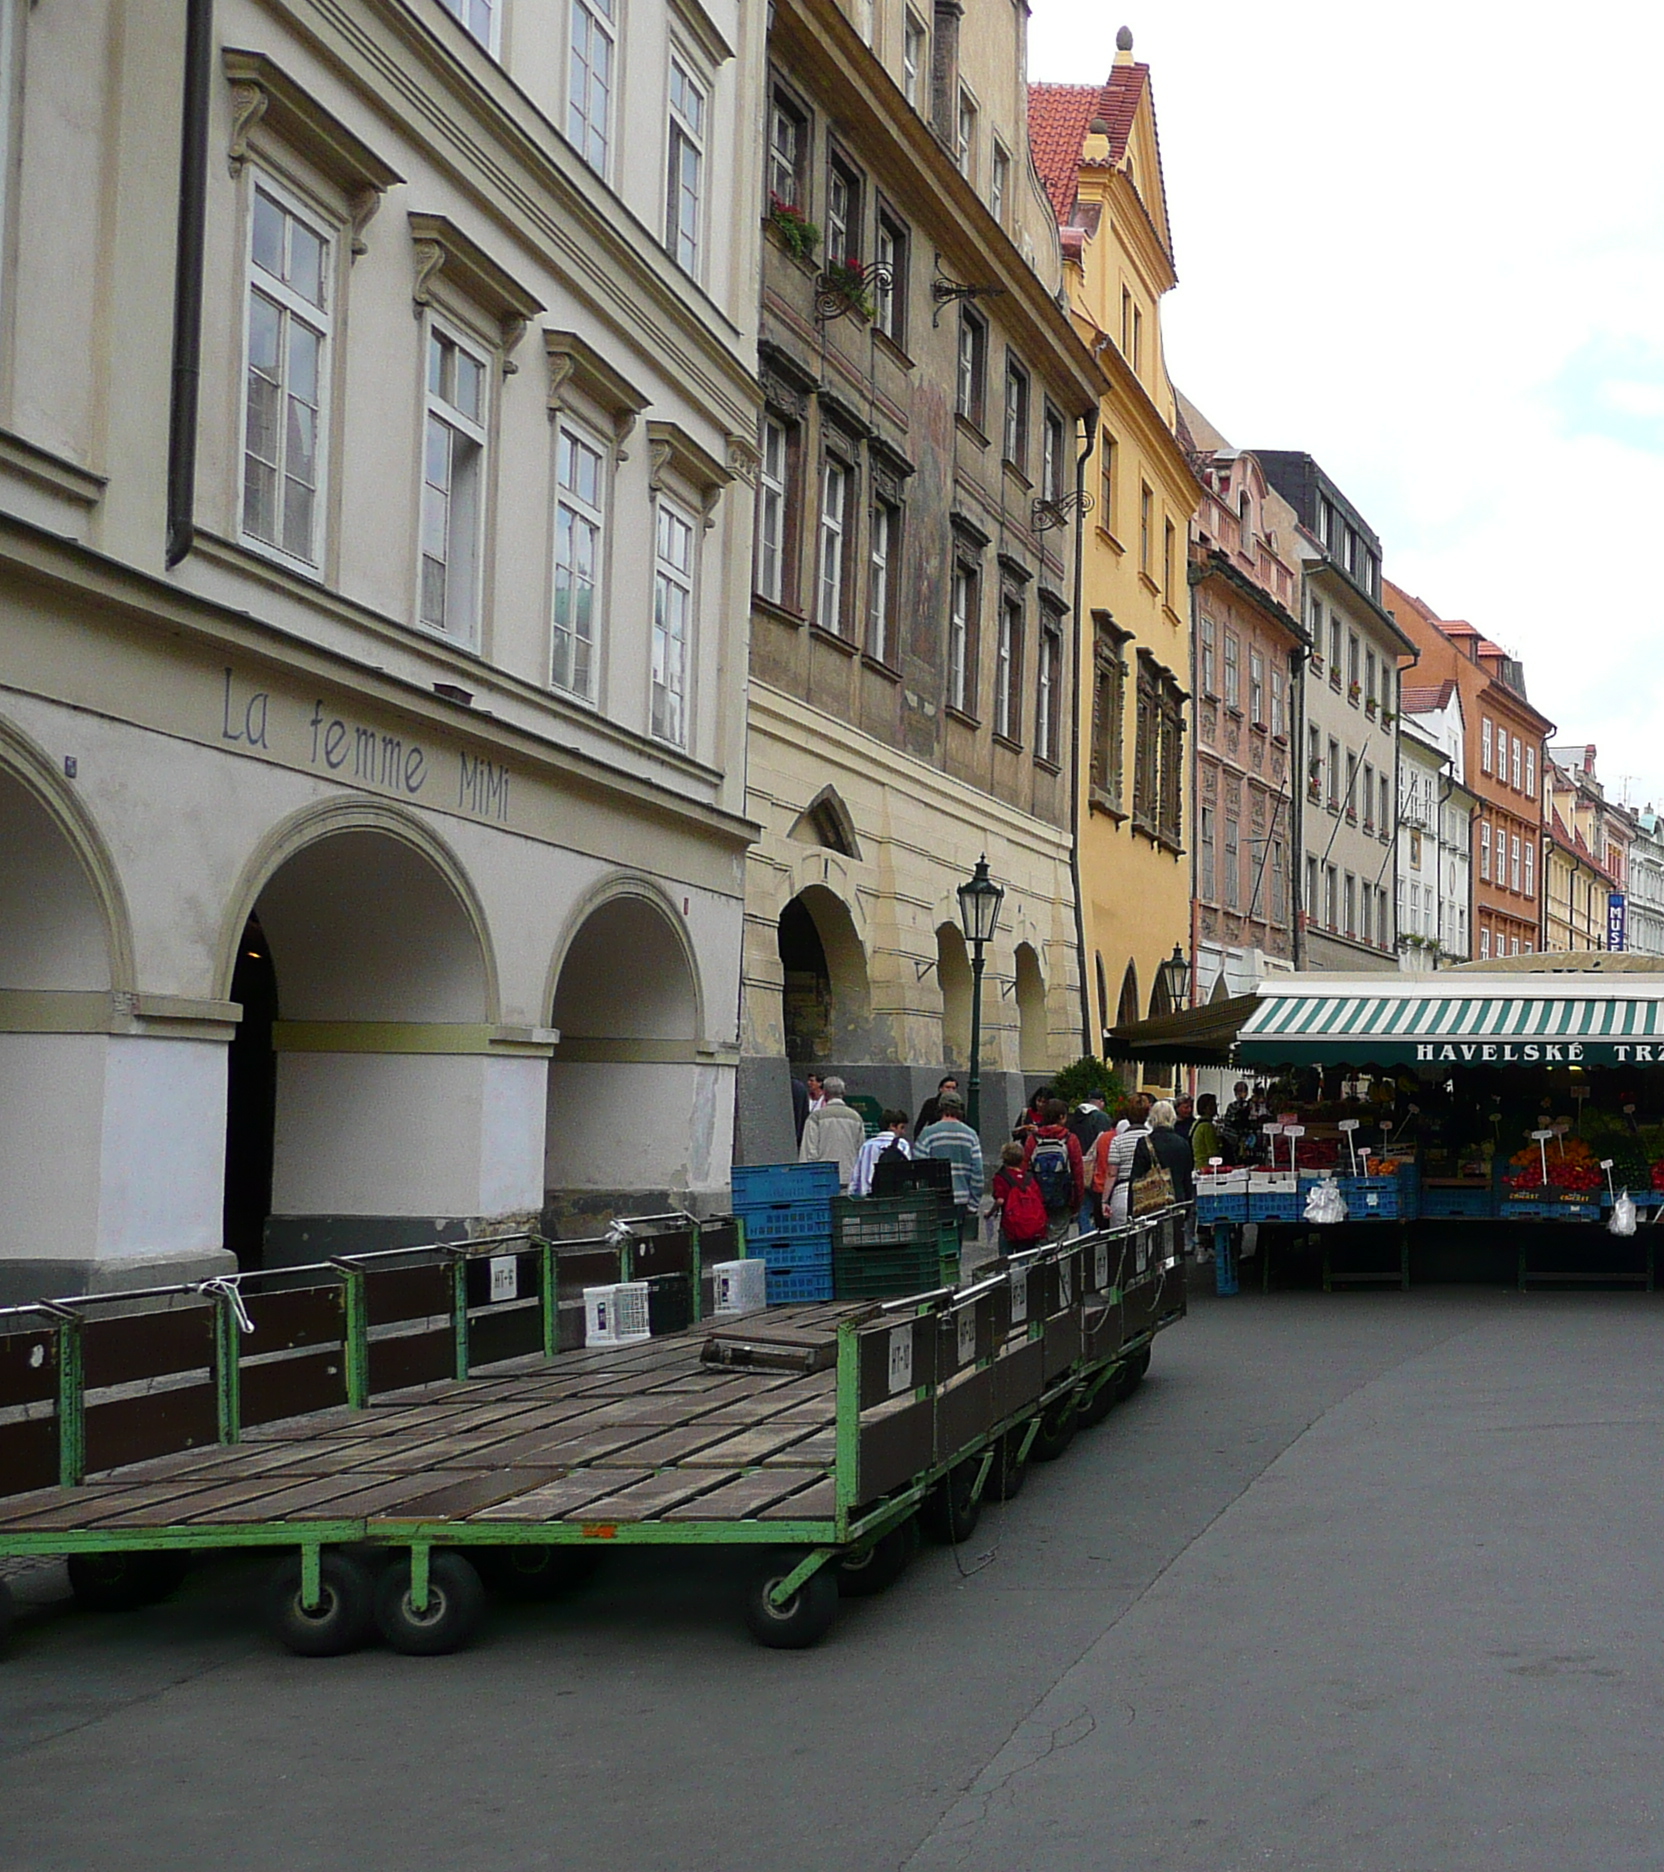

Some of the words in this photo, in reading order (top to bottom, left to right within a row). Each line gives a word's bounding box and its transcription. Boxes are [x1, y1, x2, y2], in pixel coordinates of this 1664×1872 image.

[222, 666, 269, 749] La
[310, 700, 428, 793] femme
[1416, 1042, 1585, 1061] HAVELSKÉ
